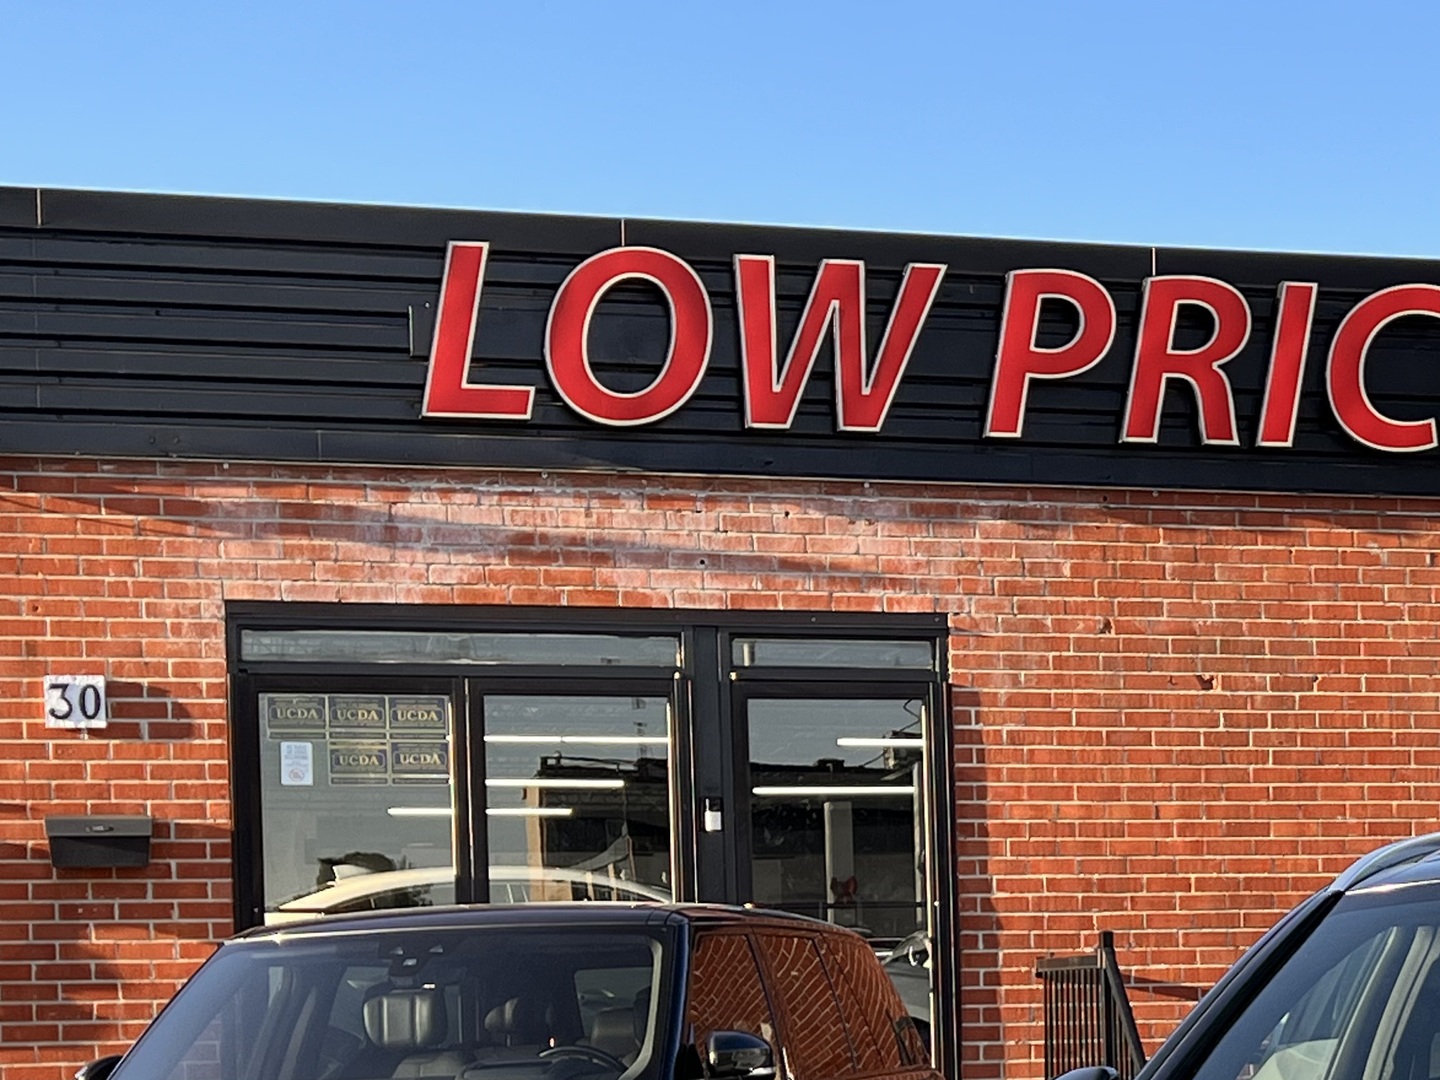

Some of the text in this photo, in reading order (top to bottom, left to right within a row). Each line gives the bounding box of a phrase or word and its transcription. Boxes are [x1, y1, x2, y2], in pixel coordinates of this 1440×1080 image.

[420, 240, 948, 432] LOW
[48, 683, 101, 720] 30
[276, 708, 319, 720] UCDA
[336, 710, 379, 721] UCDA
[397, 710, 438, 721] UCDA
[339, 755, 379, 766] UCDA
[399, 754, 441, 765] UCDA
